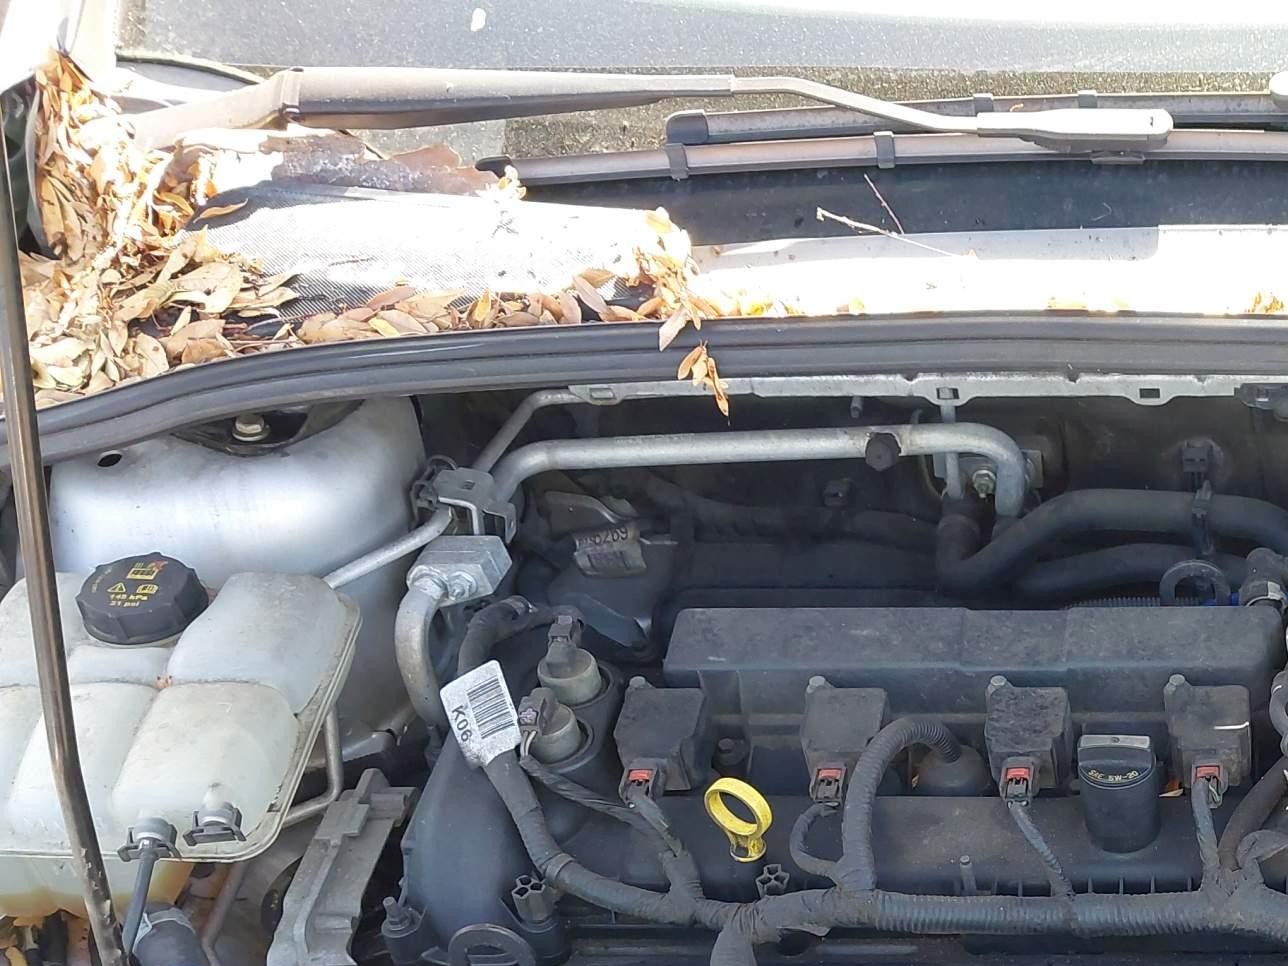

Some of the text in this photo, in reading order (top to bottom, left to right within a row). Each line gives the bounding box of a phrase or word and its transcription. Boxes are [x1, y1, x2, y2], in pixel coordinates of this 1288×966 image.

[451, 704, 473, 742] K06
[1088, 769, 1139, 781] SAE 5W-20
